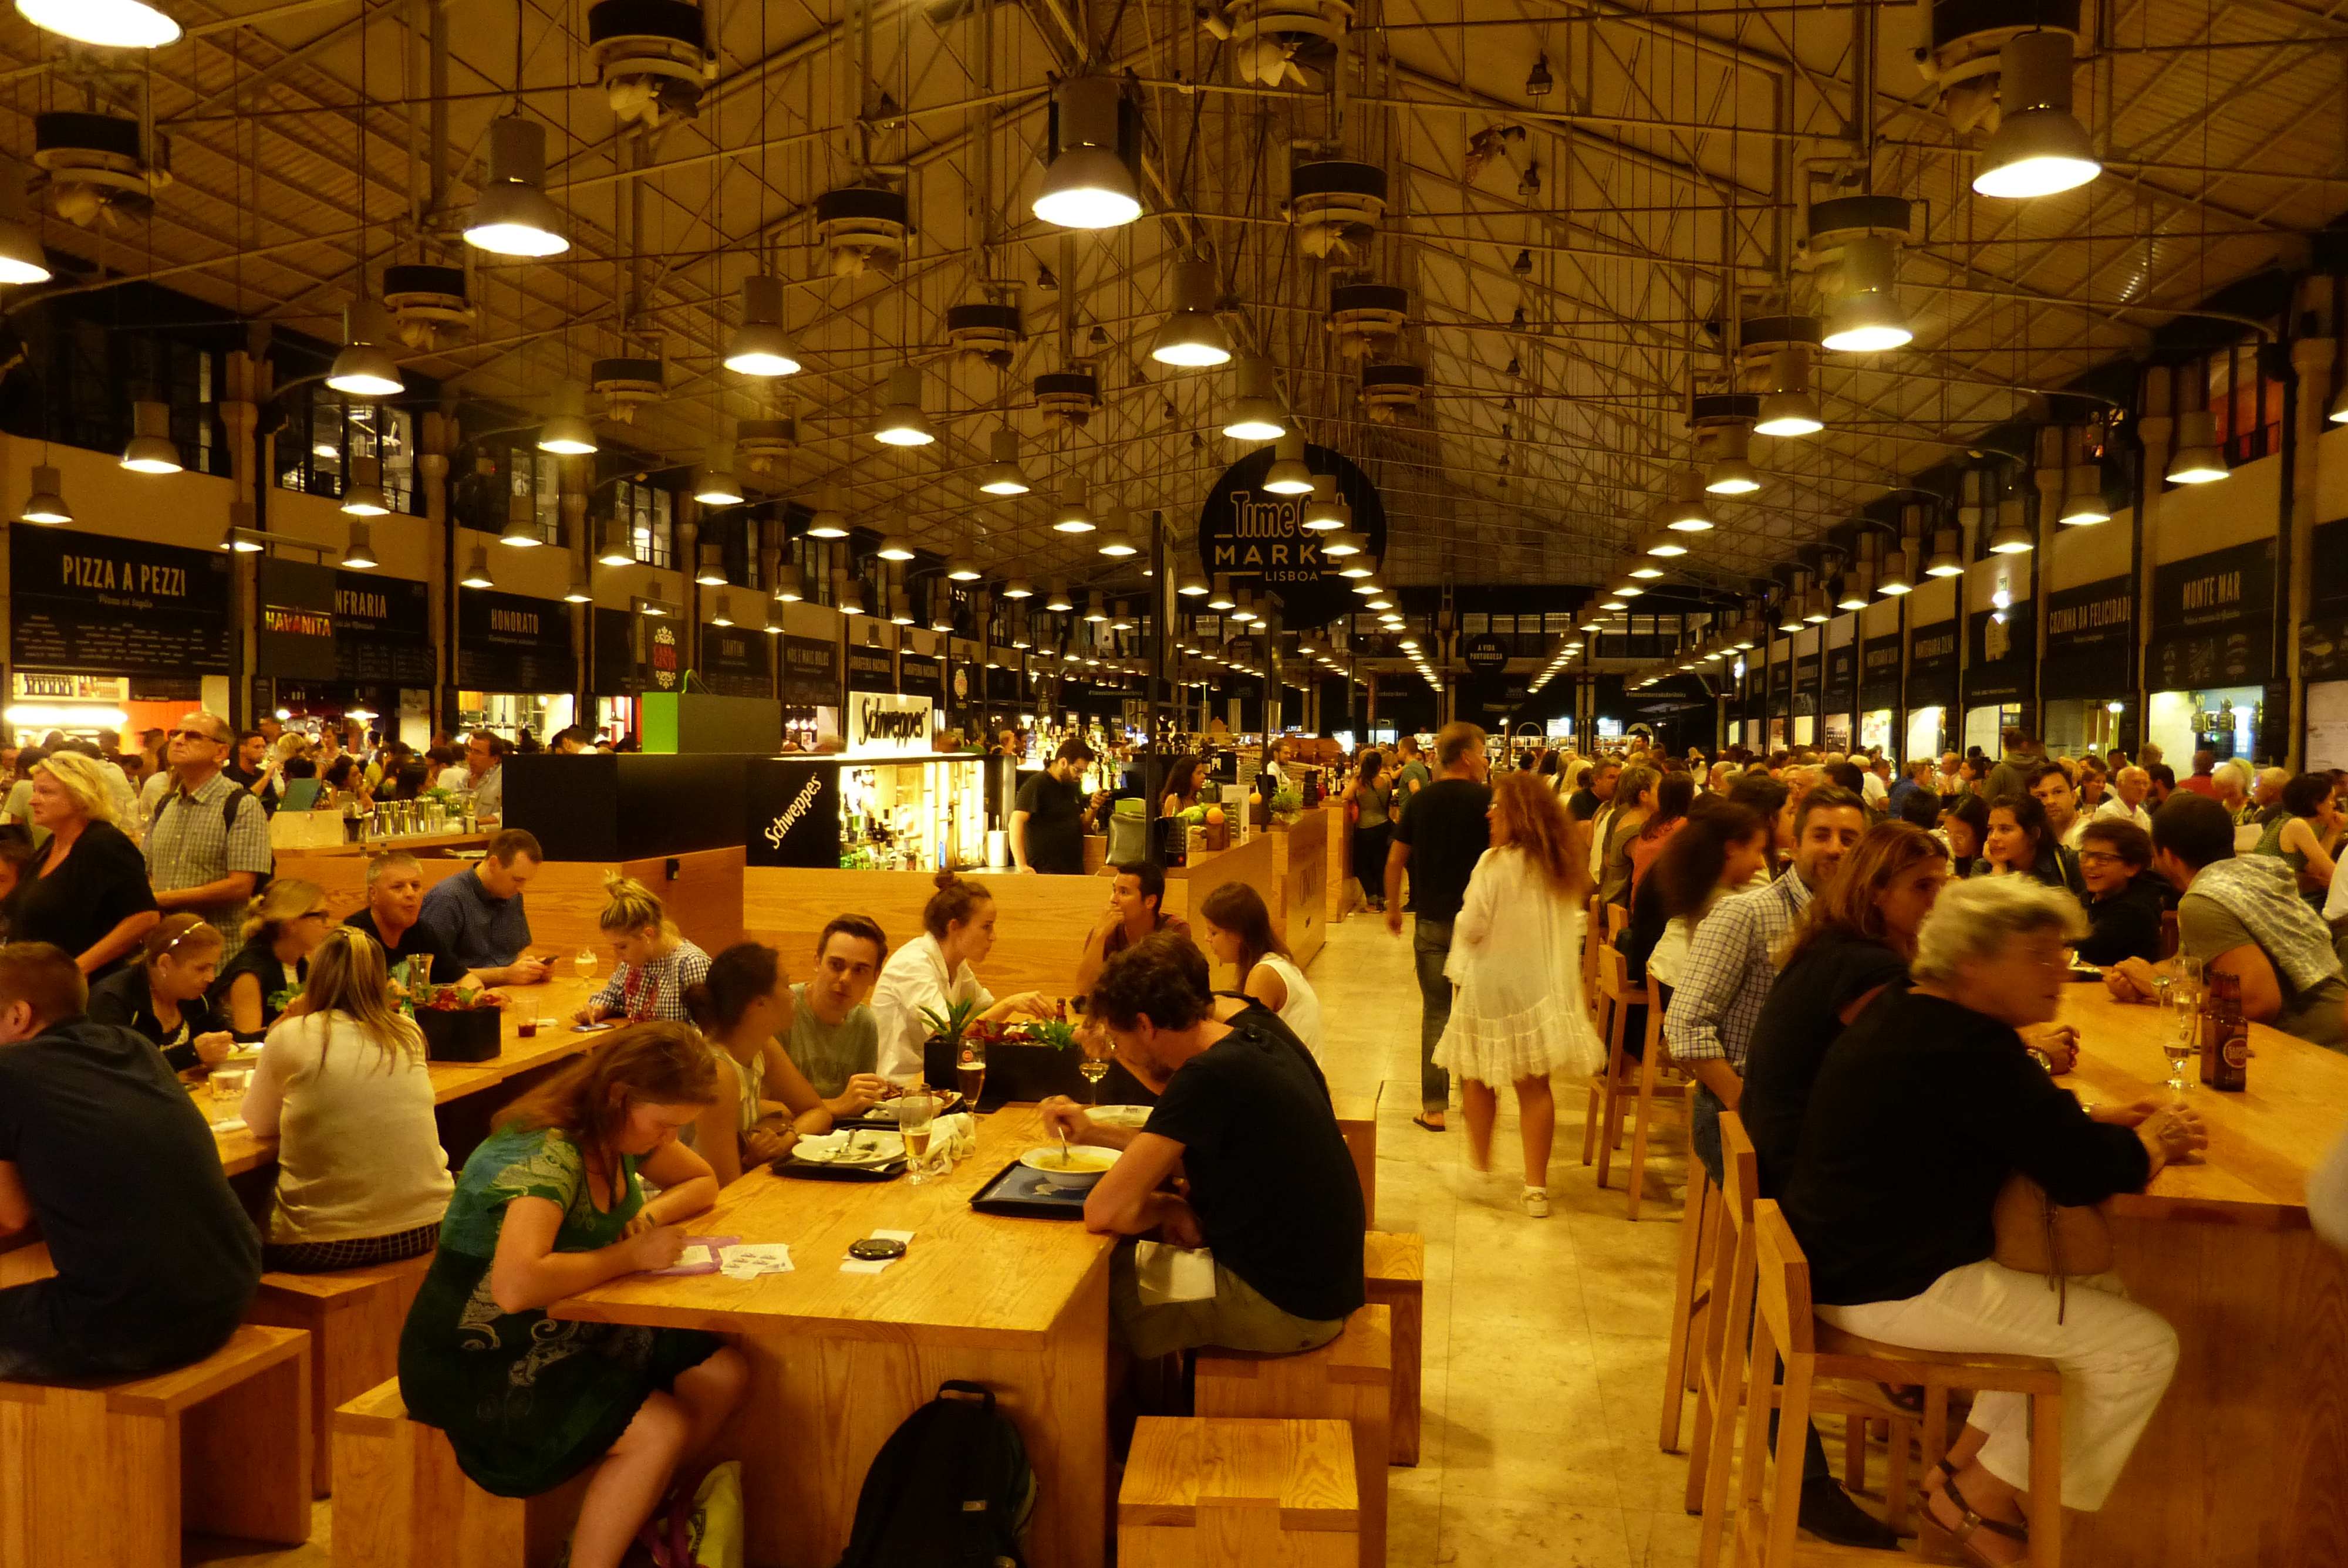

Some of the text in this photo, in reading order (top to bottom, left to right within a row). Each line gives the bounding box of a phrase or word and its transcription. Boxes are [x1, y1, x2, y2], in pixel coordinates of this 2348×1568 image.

[1215, 544, 1368, 565] MARK
[63, 555, 116, 590] PIZZA
[123, 562, 134, 592] A
[141, 565, 186, 597] PEZZI
[1266, 571, 1318, 582] LISBOA
[336, 589, 387, 618] NFRARIA
[2183, 571, 2240, 610] MONTE MAR
[265, 611, 332, 637] HAVANITA
[491, 608, 539, 634] HONORATO
[2050, 607, 2077, 634] COZINHA
[2079, 606, 2087, 630] DA
[859, 698, 927, 748] Schweppes
[765, 775, 822, 850] Schweppes
